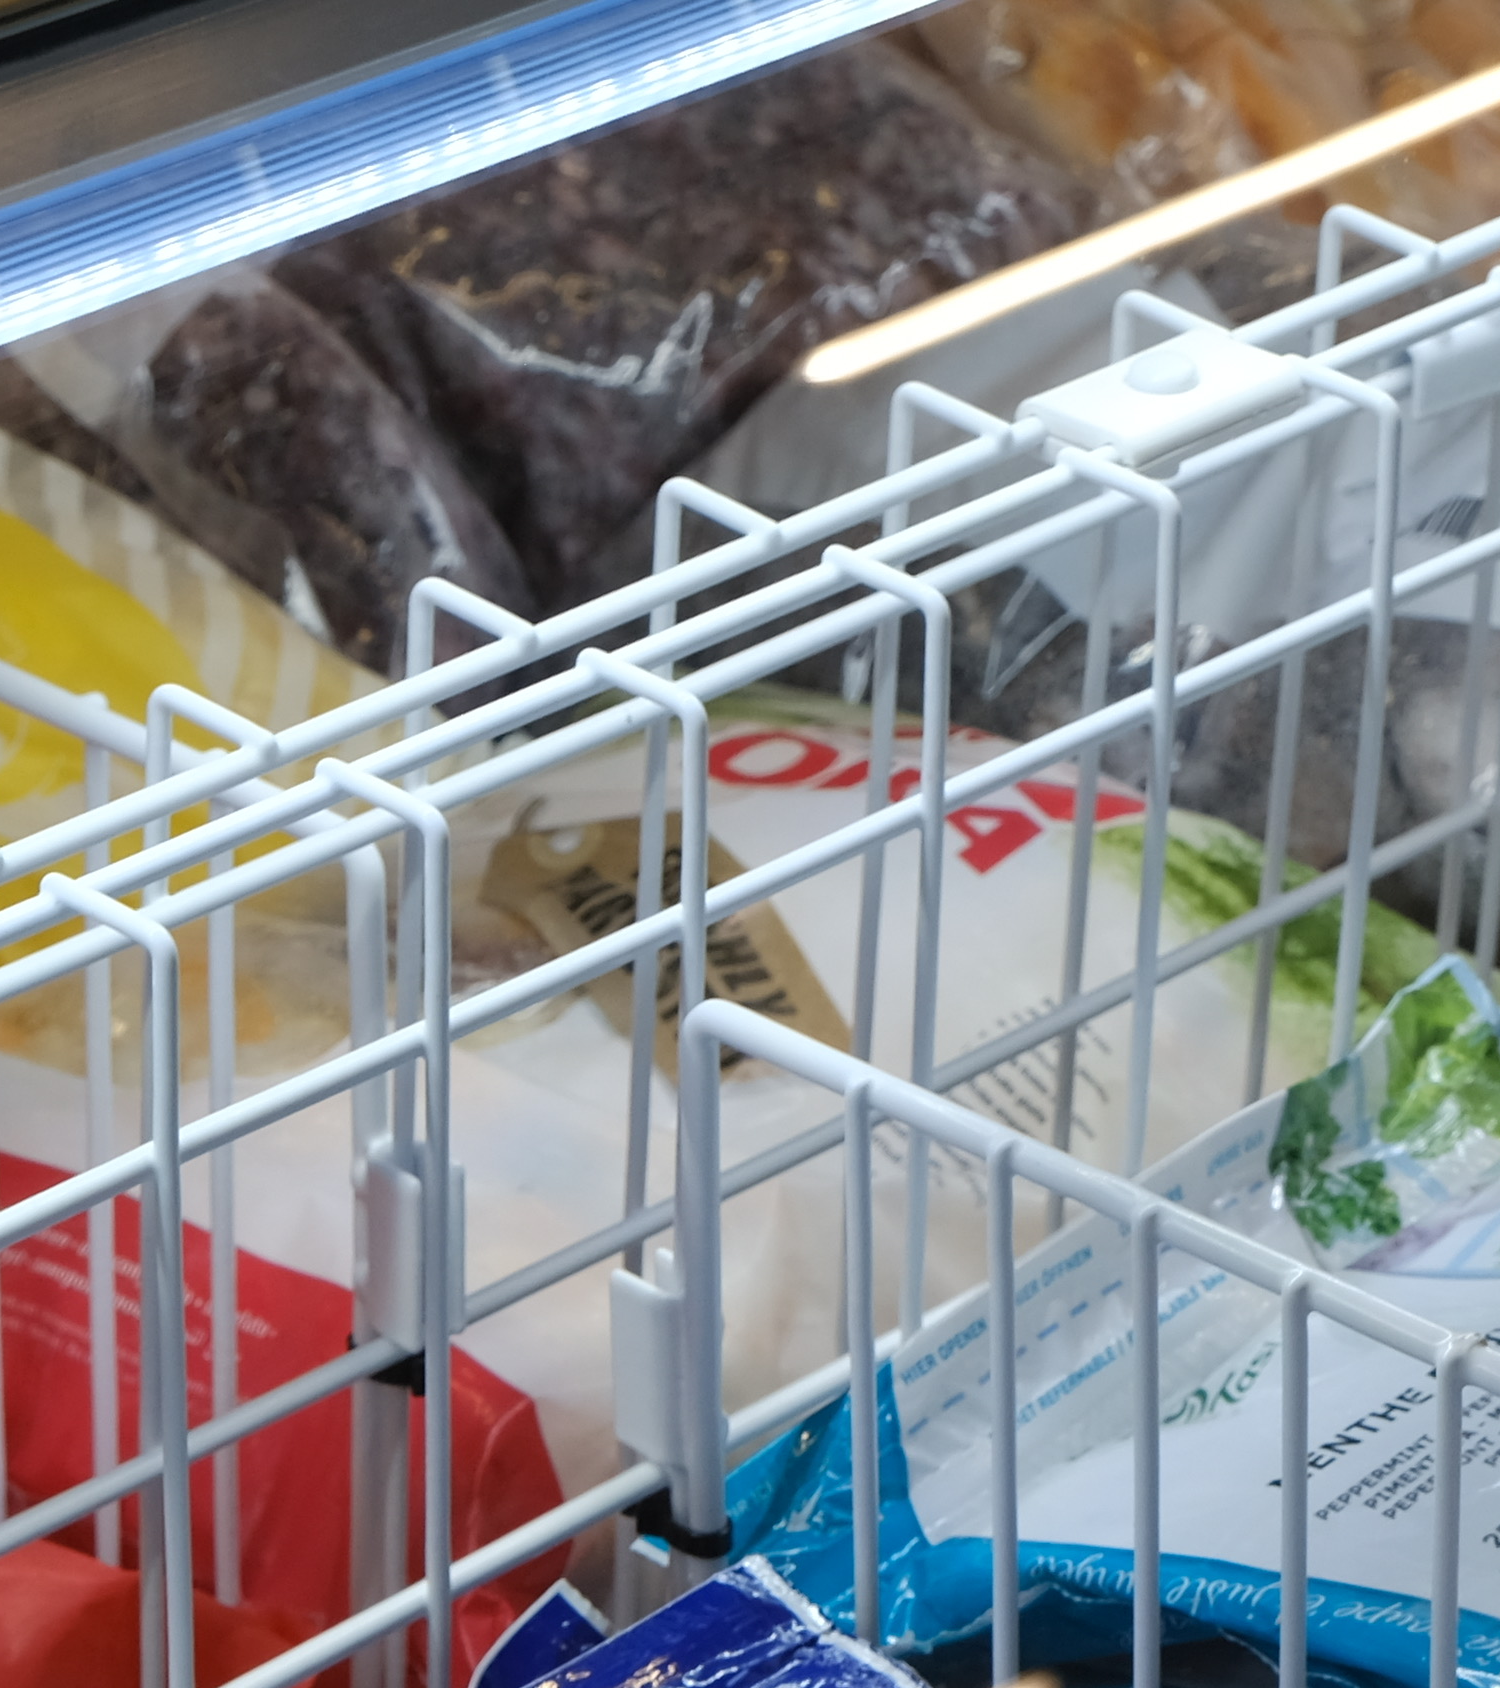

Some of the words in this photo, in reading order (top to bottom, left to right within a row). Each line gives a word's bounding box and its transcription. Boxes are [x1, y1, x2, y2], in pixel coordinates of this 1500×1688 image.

[900, 1353, 938, 1387] HIER
[936, 1317, 988, 1362] OPENEN
[1037, 1346, 1118, 1411] REFERMABLE
[1268, 1383, 1436, 1488] ENTHE
[1313, 1431, 1436, 1522] PEPPERMINT
